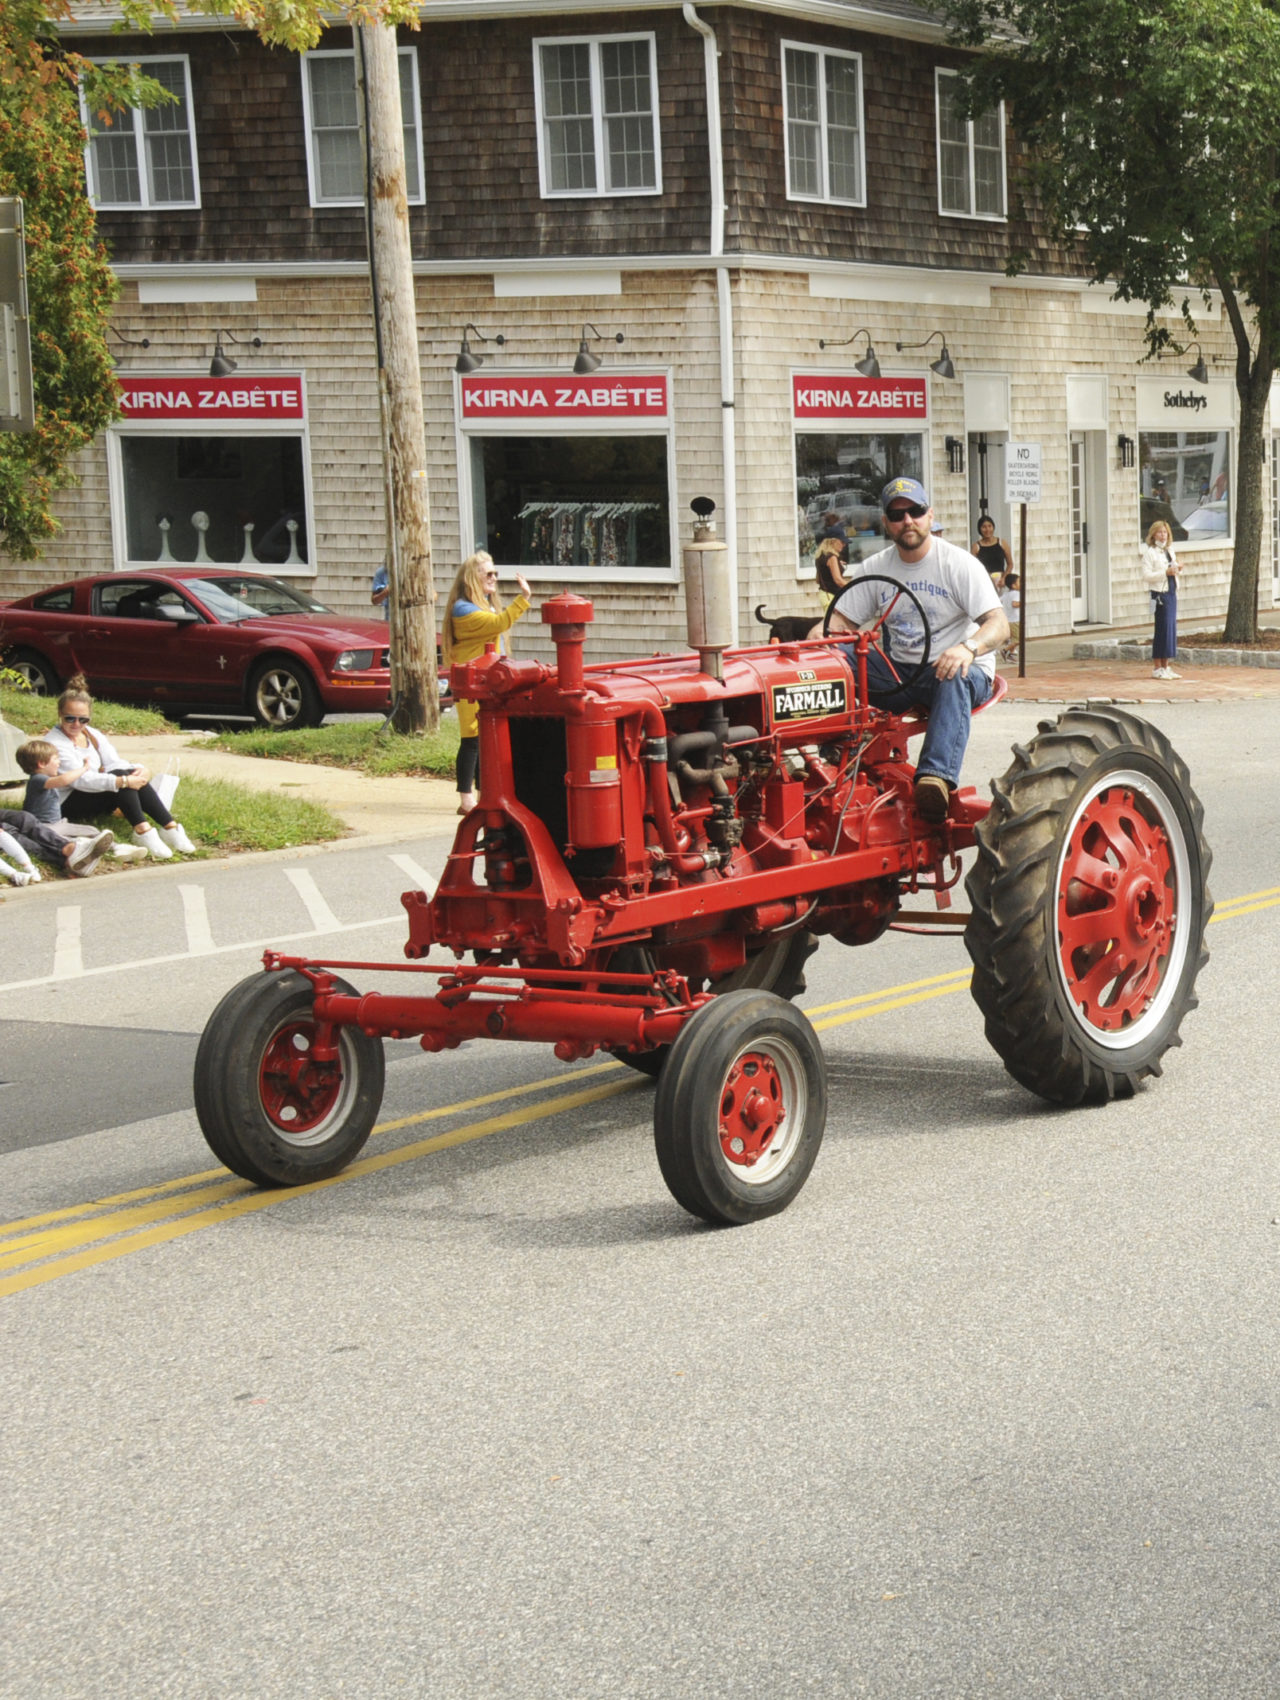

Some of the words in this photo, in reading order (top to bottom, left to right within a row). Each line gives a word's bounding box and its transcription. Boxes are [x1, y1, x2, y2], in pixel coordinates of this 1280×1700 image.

[116, 391, 193, 409] KIRNA
[198, 385, 299, 408] ZABÊTE
[464, 389, 549, 408] KIRNA
[554, 383, 664, 407] ZABÊTE
[796, 389, 854, 408] KIRNA
[856, 385, 925, 408] ZABÊTE
[1163, 389, 1208, 412] Sotheby's
[1017, 448, 1030, 459] NO
[775, 688, 845, 713] FARMALL
